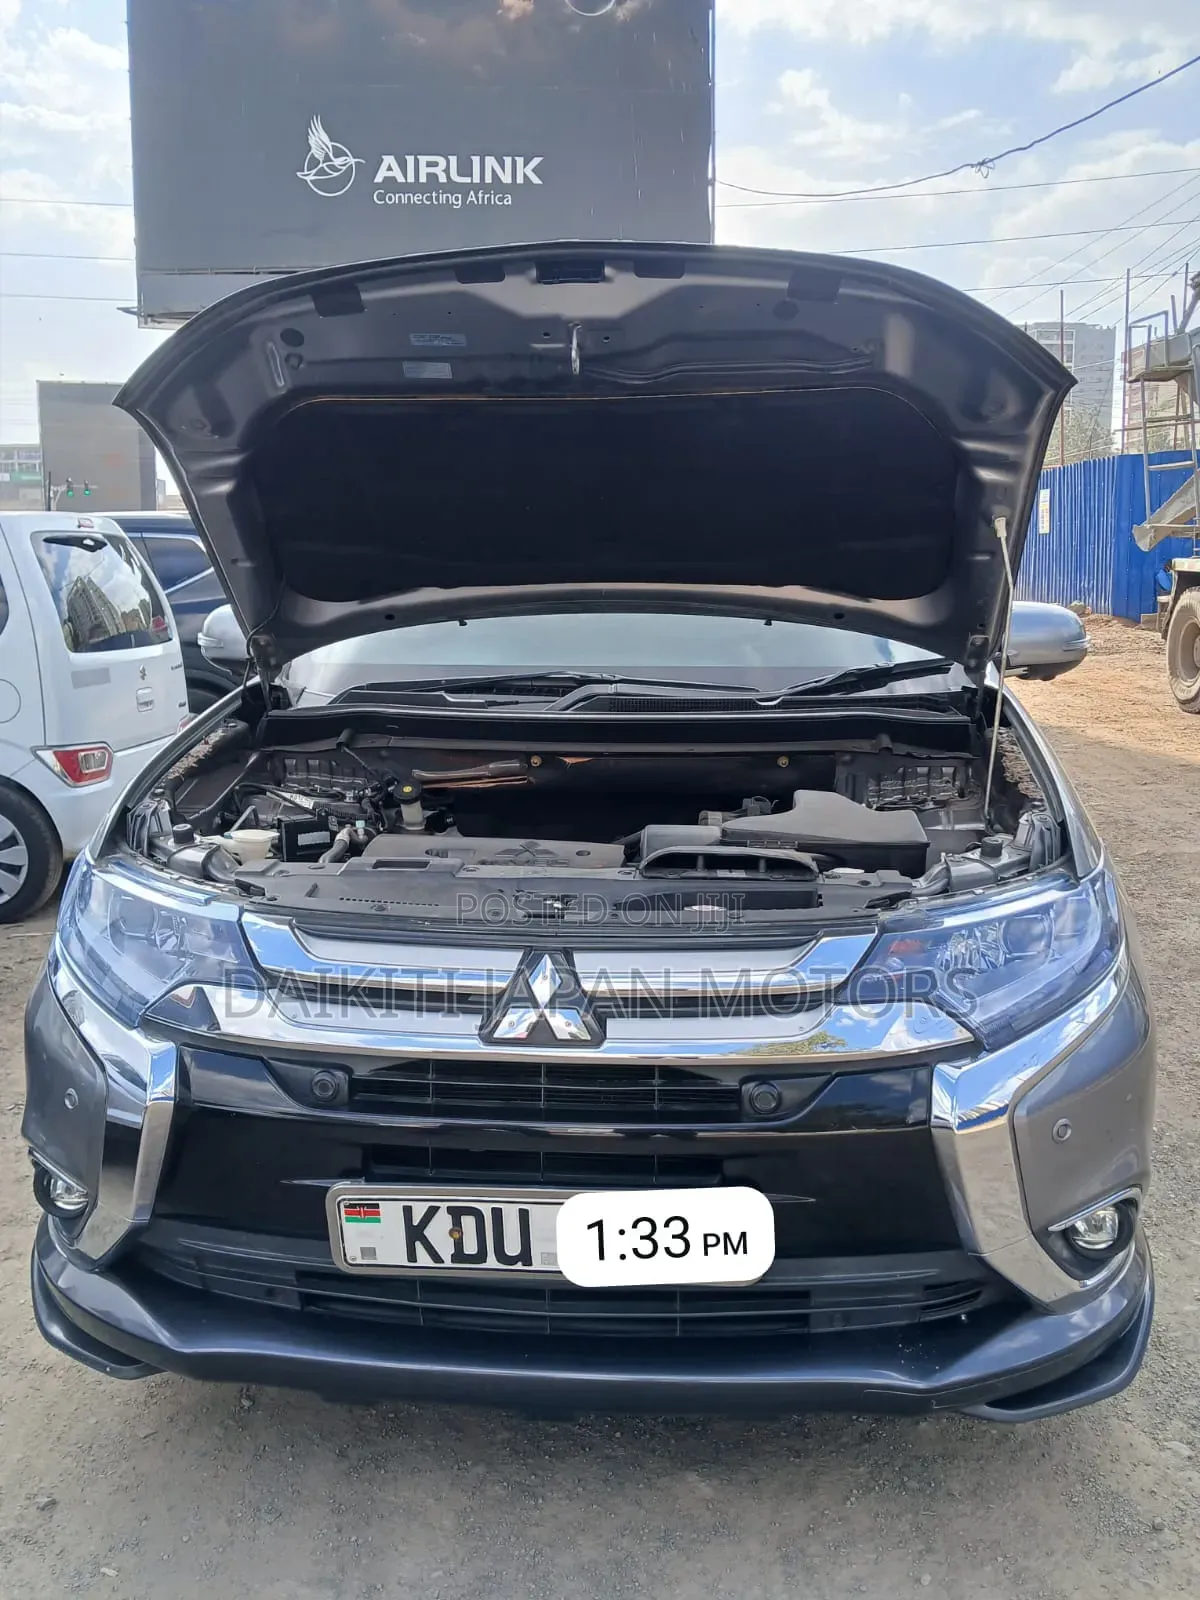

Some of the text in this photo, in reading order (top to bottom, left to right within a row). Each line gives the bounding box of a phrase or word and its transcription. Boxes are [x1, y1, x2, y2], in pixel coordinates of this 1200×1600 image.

[373, 155, 544, 184] AIRLINK
[373, 190, 512, 208] Connecting Africa
[402, 1205, 533, 1266] KDU
